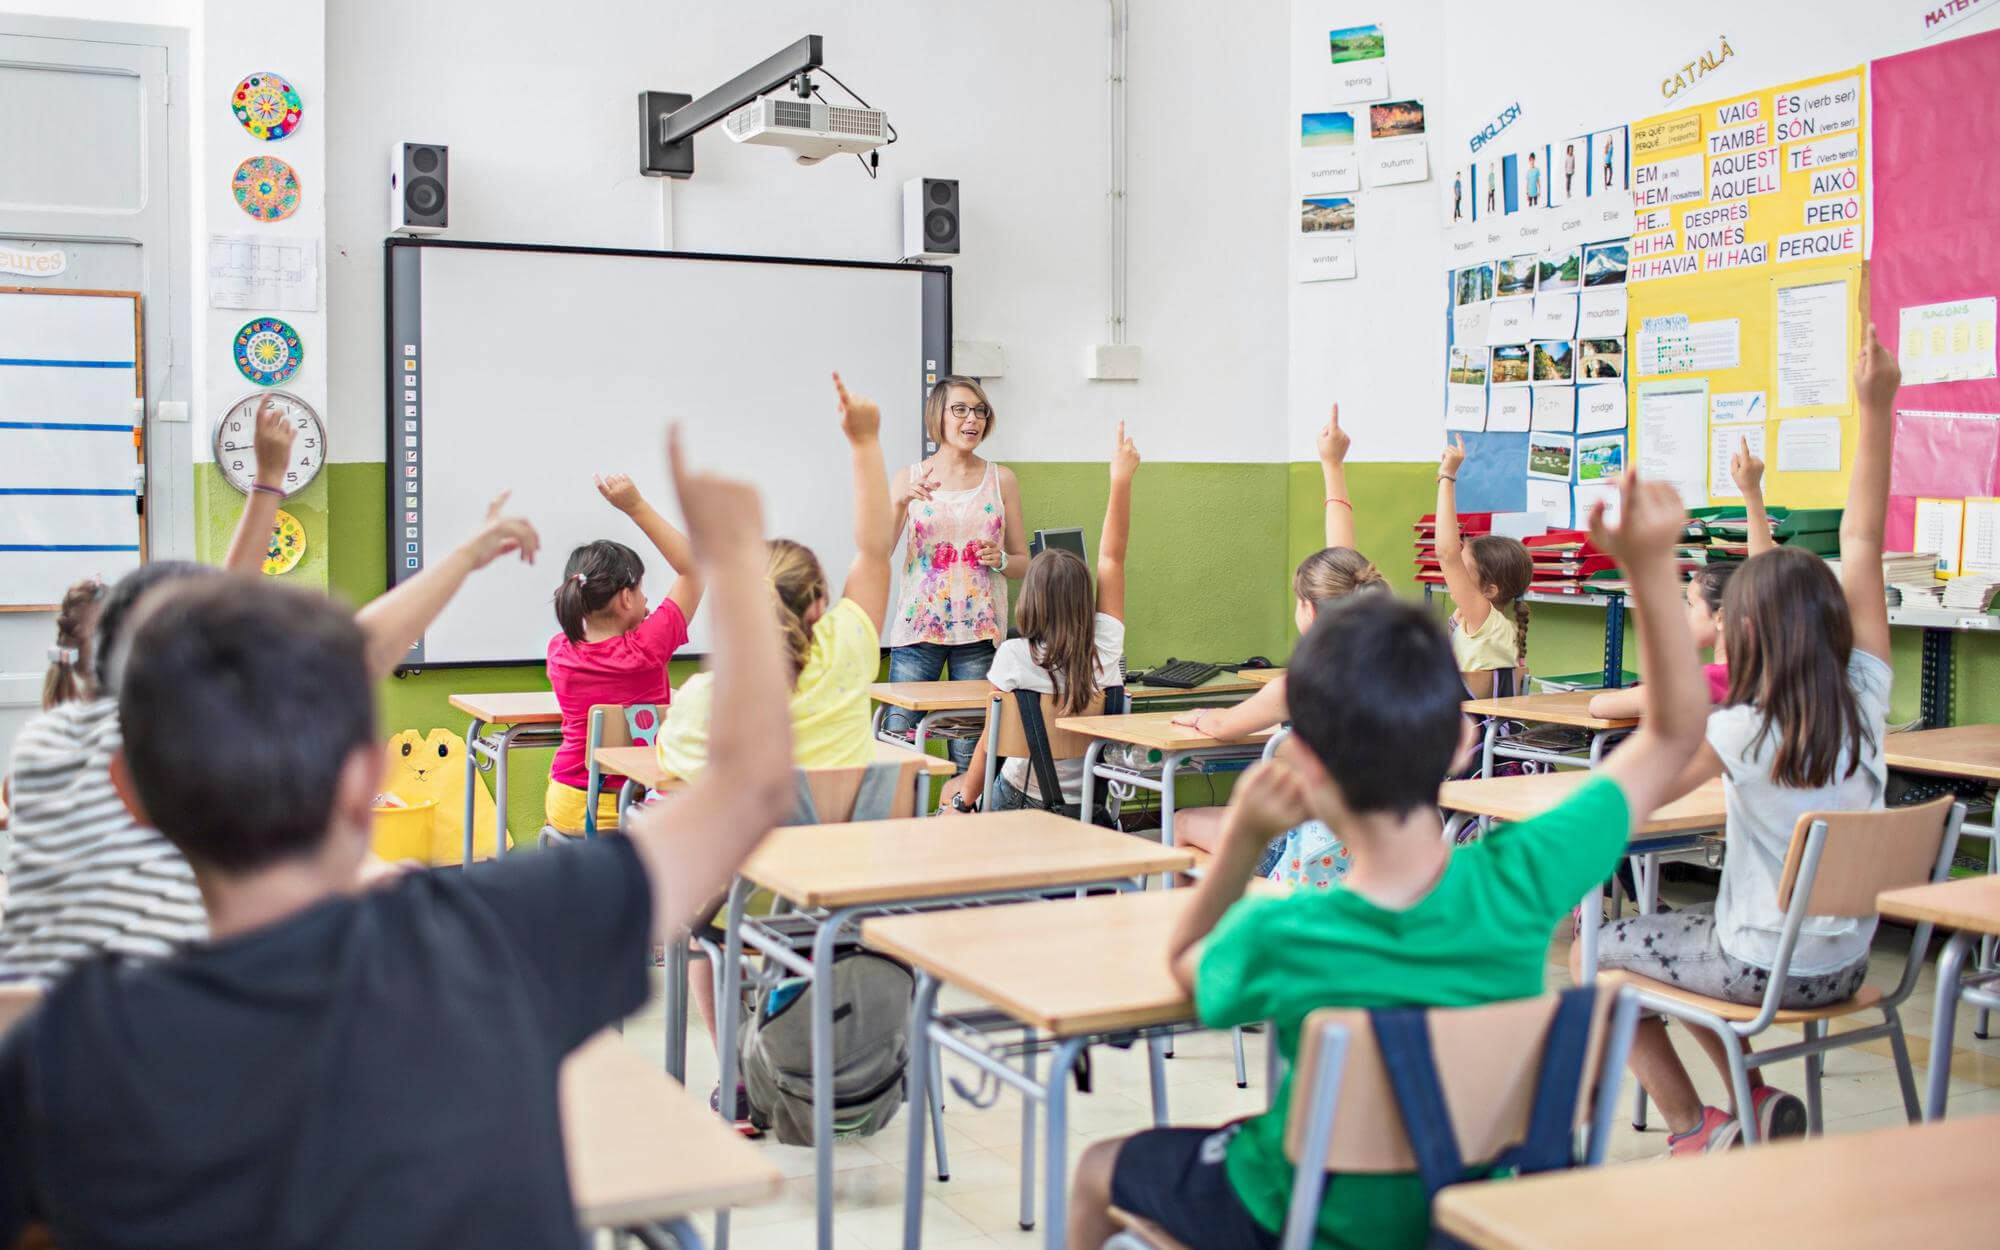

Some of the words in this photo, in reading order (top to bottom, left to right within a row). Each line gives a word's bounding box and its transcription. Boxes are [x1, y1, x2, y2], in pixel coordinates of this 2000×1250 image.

[1925, 0, 1980, 28] MATE
[1662, 35, 1734, 98] CATALÀ
[1344, 77, 1372, 88] spring
[1719, 101, 1758, 125] VAIG
[1777, 95, 1800, 116] ÉS
[1804, 95, 1832, 113] (verb
[1835, 88, 1856, 104] ser)
[1470, 101, 1521, 153] ENGLISH
[1710, 123, 1766, 152] TAMBÉ
[1777, 117, 1815, 141] SÓN
[1819, 121, 1839, 134] (verb
[1841, 117, 1856, 129] ser)
[1381, 158, 1414, 169] autumn
[1711, 148, 1778, 178] AQUEST
[1792, 145, 1812, 169] TÉ
[1817, 154, 1837, 167] (Verb
[1839, 148, 1858, 161] tenir)
[1311, 168, 1347, 177] summer
[1636, 166, 1658, 184] EM
[1813, 168, 1856, 194] AIXÒ
[1635, 187, 1669, 207] HEM
[1711, 175, 1776, 201] AQUELL
[1685, 204, 1748, 229] DESPRÉS
[1807, 197, 1858, 224] PERÒ
[1634, 238, 1649, 256] HI
[1653, 233, 1675, 252] HA
[1687, 226, 1745, 251] NOMÉS
[1779, 228, 1855, 258] PERQUÈ
[1312, 255, 1339, 264] winter
[1631, 263, 1646, 279] HI
[1651, 256, 1697, 277] HAVIA
[1707, 253, 1723, 269] HI
[1727, 245, 1767, 266] HAGI
[1586, 308, 1620, 318] mountain
[244, 407, 252, 417] 11
[1591, 402, 1614, 413] bridge
[230, 422, 241, 432] 10
[297, 418, 308, 429] 2
[304, 438, 315, 448] 3
[232, 460, 244, 471] 8
[300, 457, 310, 467] 4
[287, 472, 298, 482] 5
